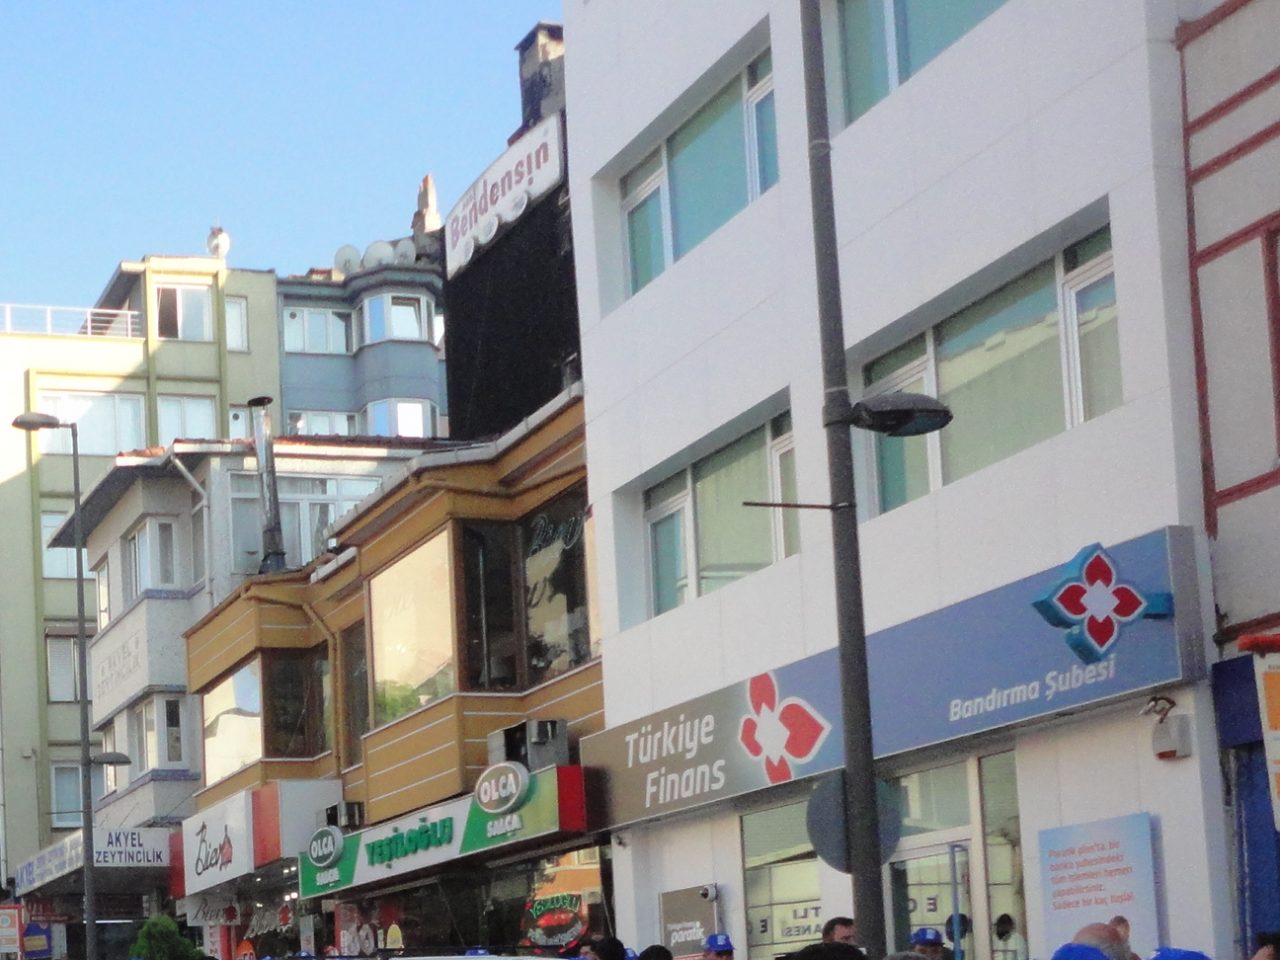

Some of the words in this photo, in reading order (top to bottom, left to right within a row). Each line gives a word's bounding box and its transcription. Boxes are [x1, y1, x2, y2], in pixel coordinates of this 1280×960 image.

[949, 680, 1040, 722] Bandırma
[1045, 653, 1117, 701] Şubesi
[625, 713, 715, 769] Türkiye
[479, 773, 517, 803] OLCA
[645, 759, 726, 808] Finans
[106, 831, 144, 848] AKYEL
[310, 835, 335, 857] OLCA
